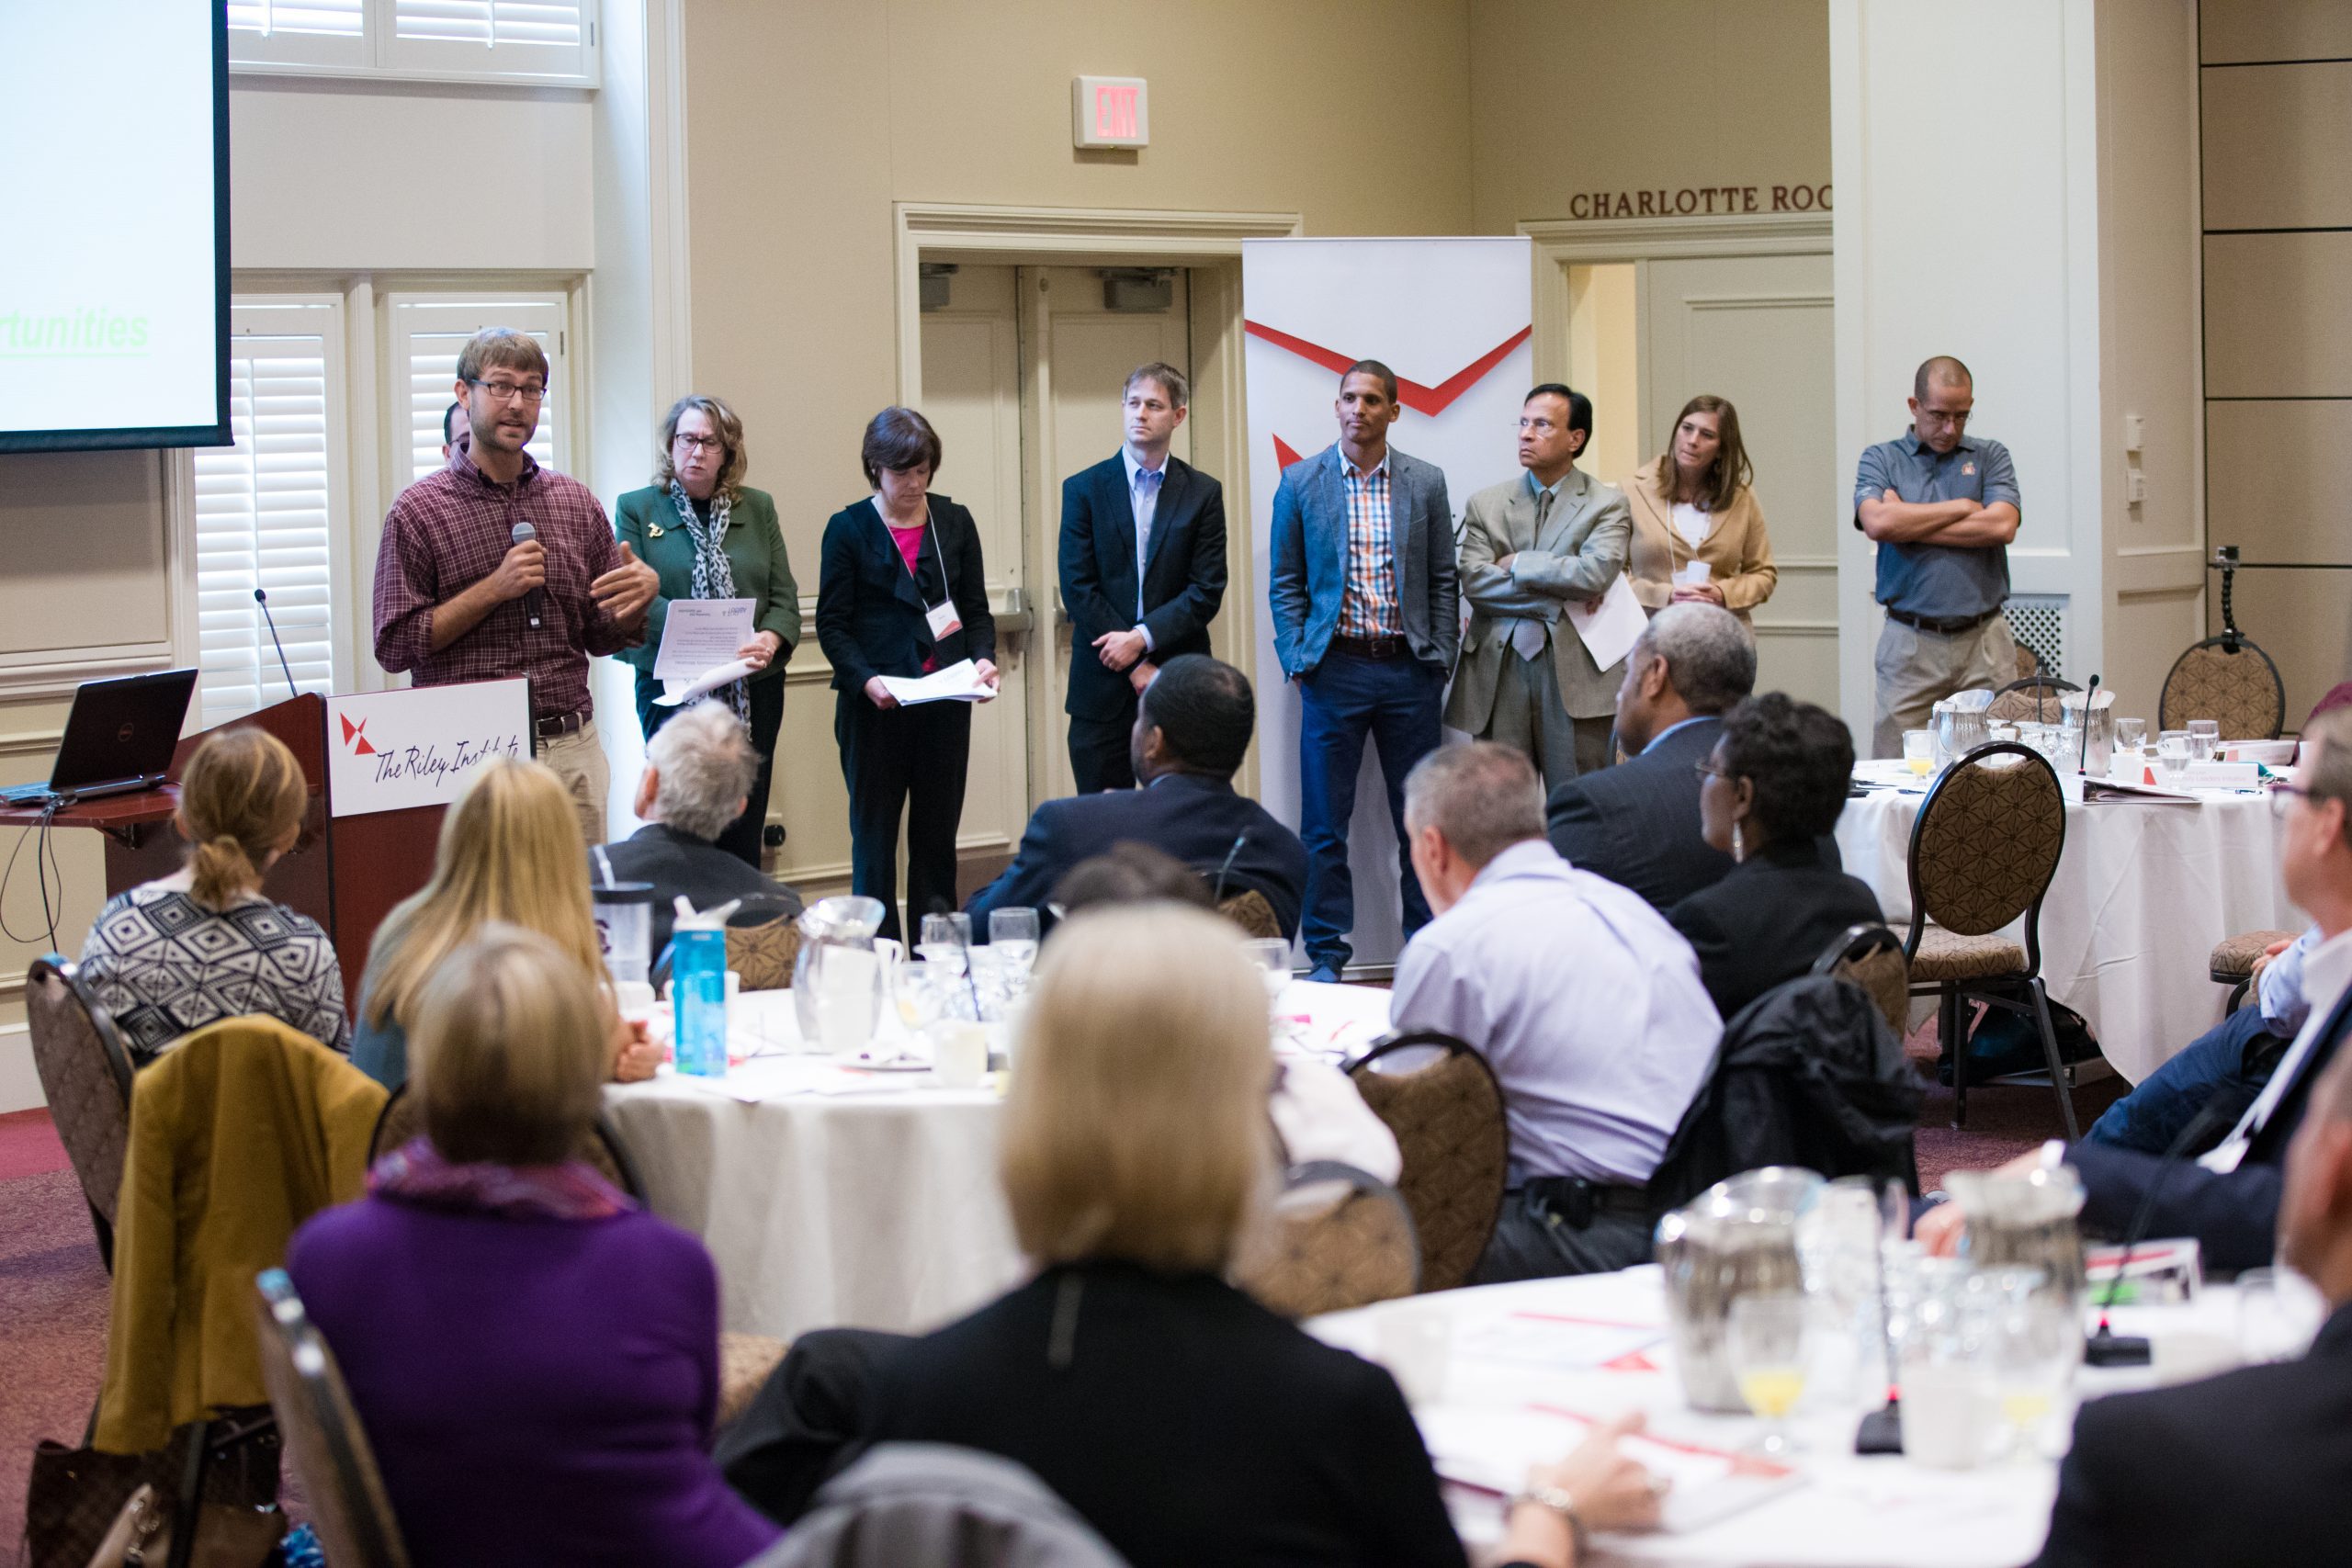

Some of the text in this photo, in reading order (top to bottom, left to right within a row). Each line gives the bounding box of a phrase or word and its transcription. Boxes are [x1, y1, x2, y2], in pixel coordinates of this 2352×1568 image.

[1096, 85, 1139, 138] EXIT
[1570, 186, 1758, 220] CHARLOTTE
[375, 734, 519, 787] The Riley Insttte
